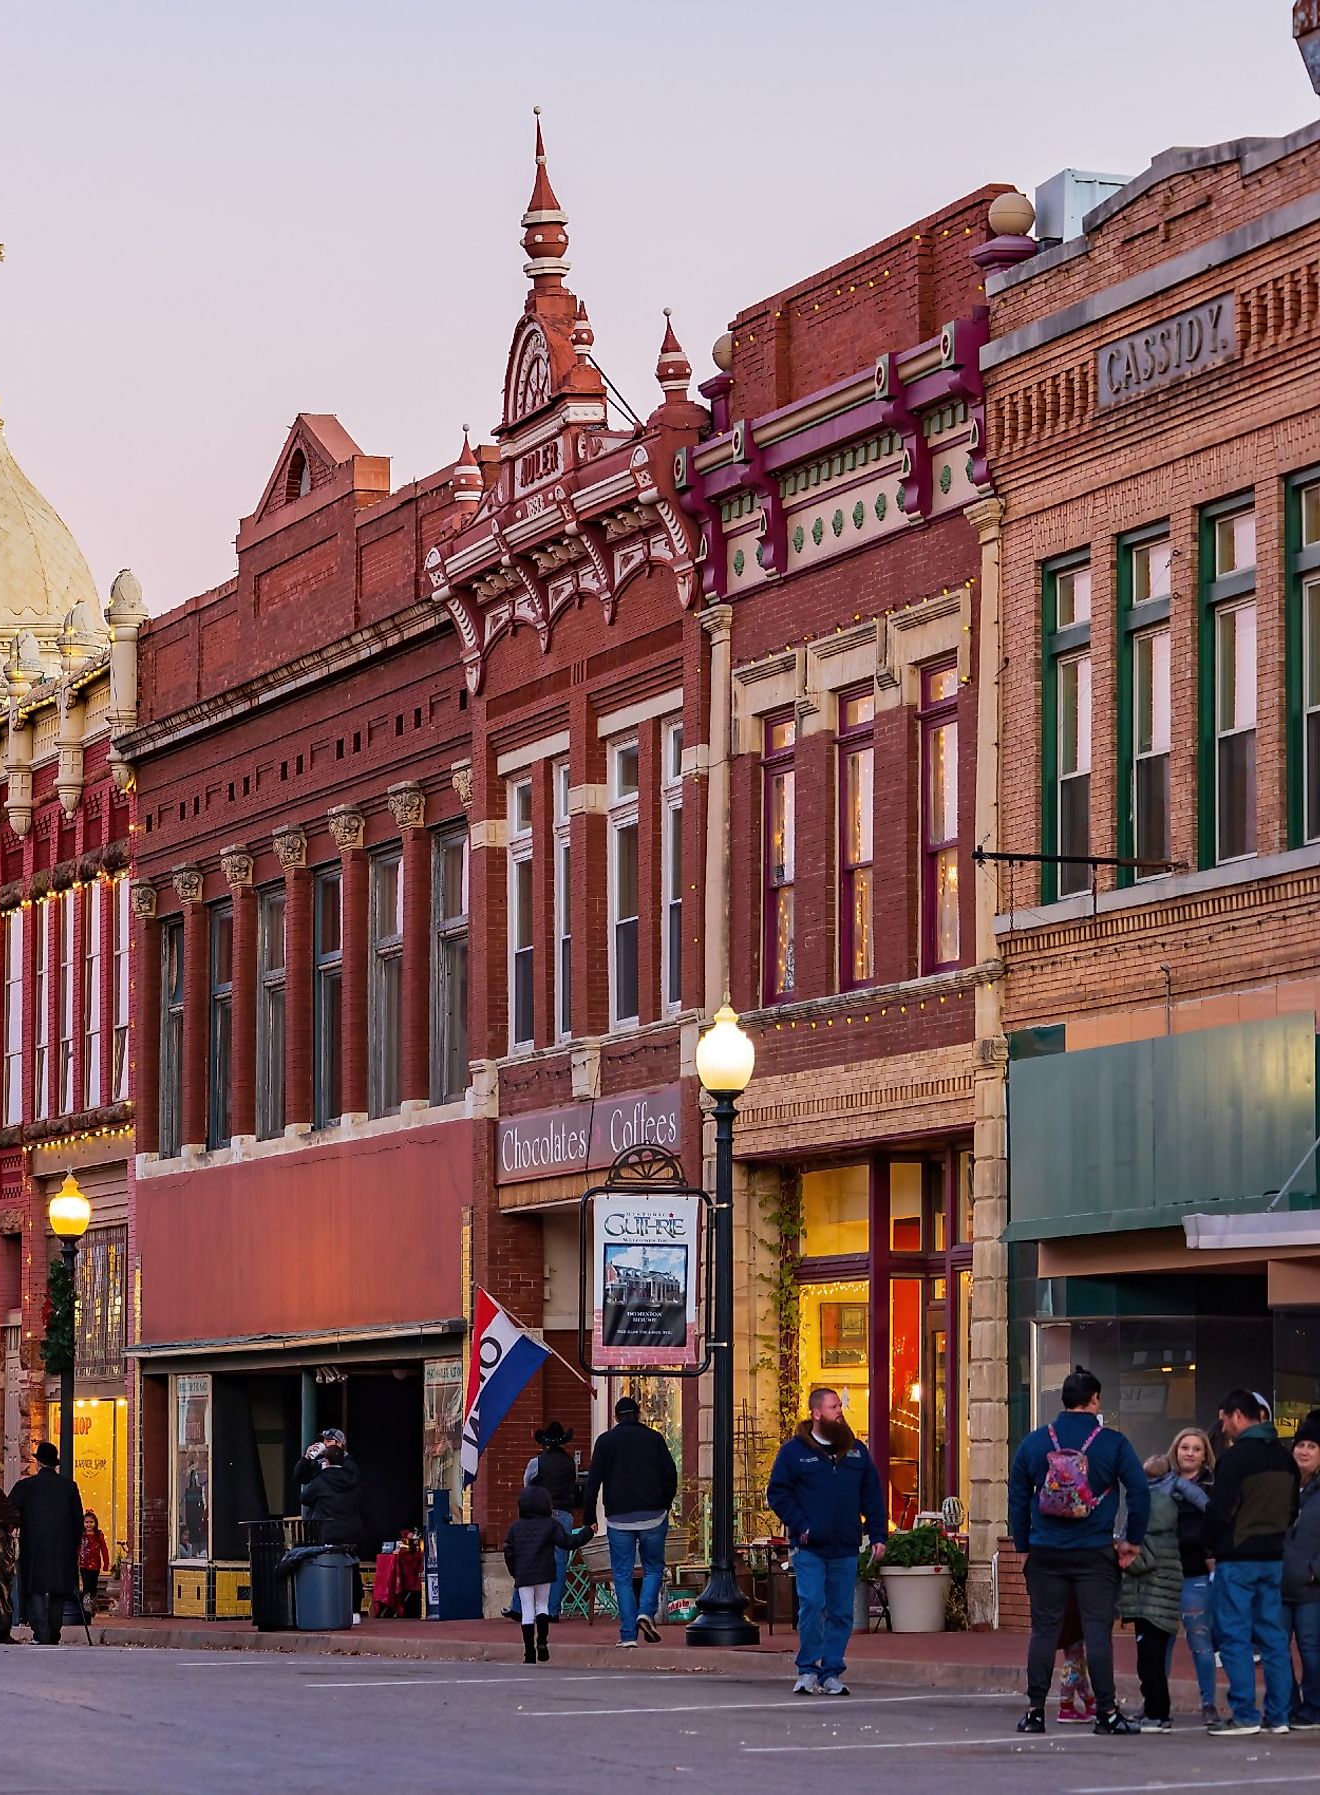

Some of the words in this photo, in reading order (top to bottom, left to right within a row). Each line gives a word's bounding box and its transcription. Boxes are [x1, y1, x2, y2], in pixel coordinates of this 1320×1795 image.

[520, 441, 559, 488] ADLER
[502, 1119, 586, 1172] Chocolates
[610, 1101, 677, 1153] Coffees
[604, 1213, 687, 1239] GUTHRIE
